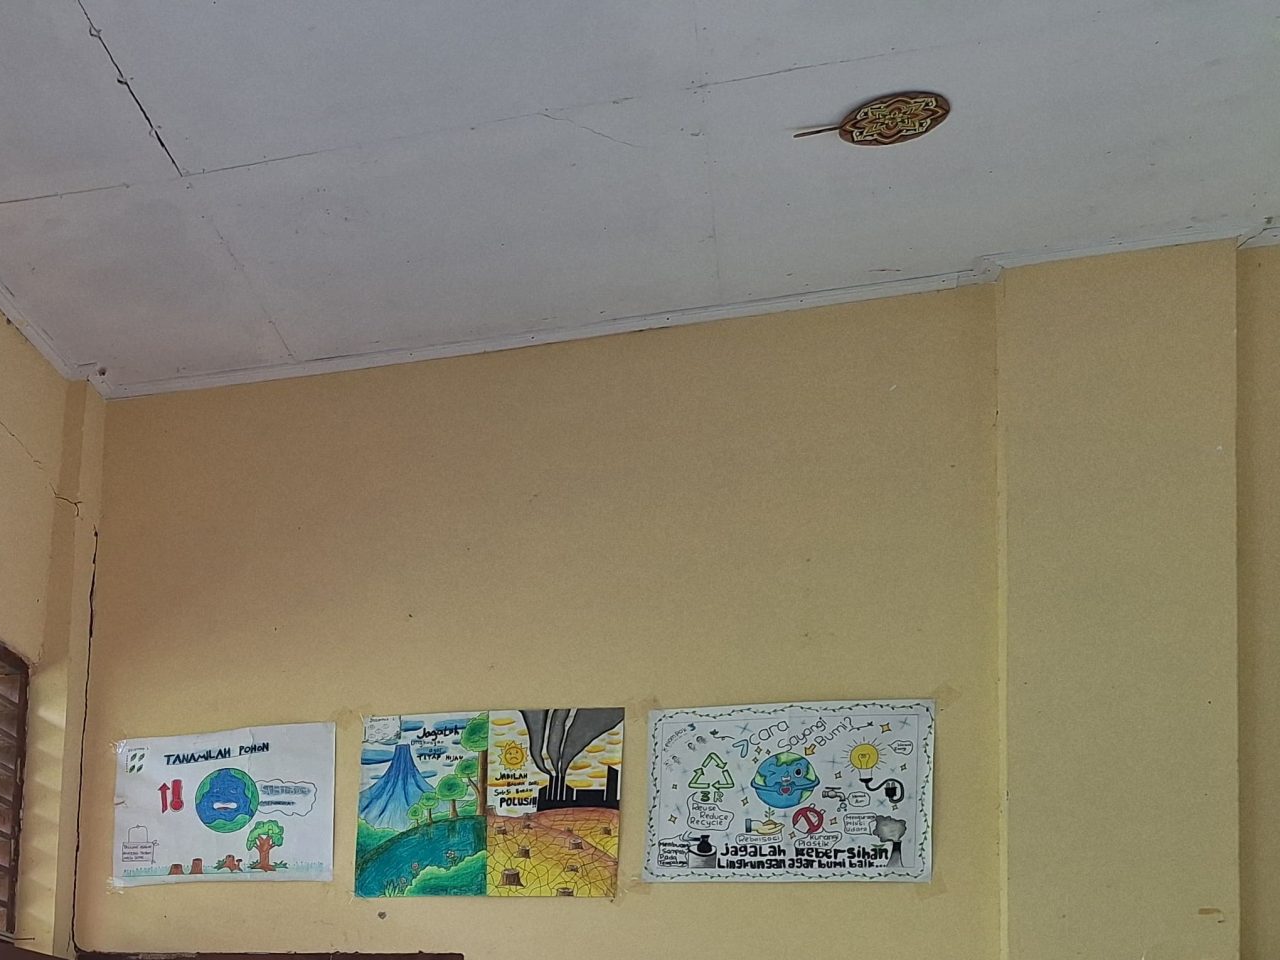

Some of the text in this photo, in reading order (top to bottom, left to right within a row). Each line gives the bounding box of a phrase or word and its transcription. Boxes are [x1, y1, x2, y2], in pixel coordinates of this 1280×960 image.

[778, 716, 828, 752] Sayangi
[814, 716, 855, 747] Bumi?
[163, 746, 231, 766] TANAMILAH
[691, 802, 717, 812] Reuse
[699, 811, 729, 821] Reduce
[689, 816, 723, 829] Recycle
[798, 839, 830, 848] Plastik
[716, 857, 787, 869] Lingkungan
[788, 858, 817, 869] agar
[817, 859, 846, 869] bumi
